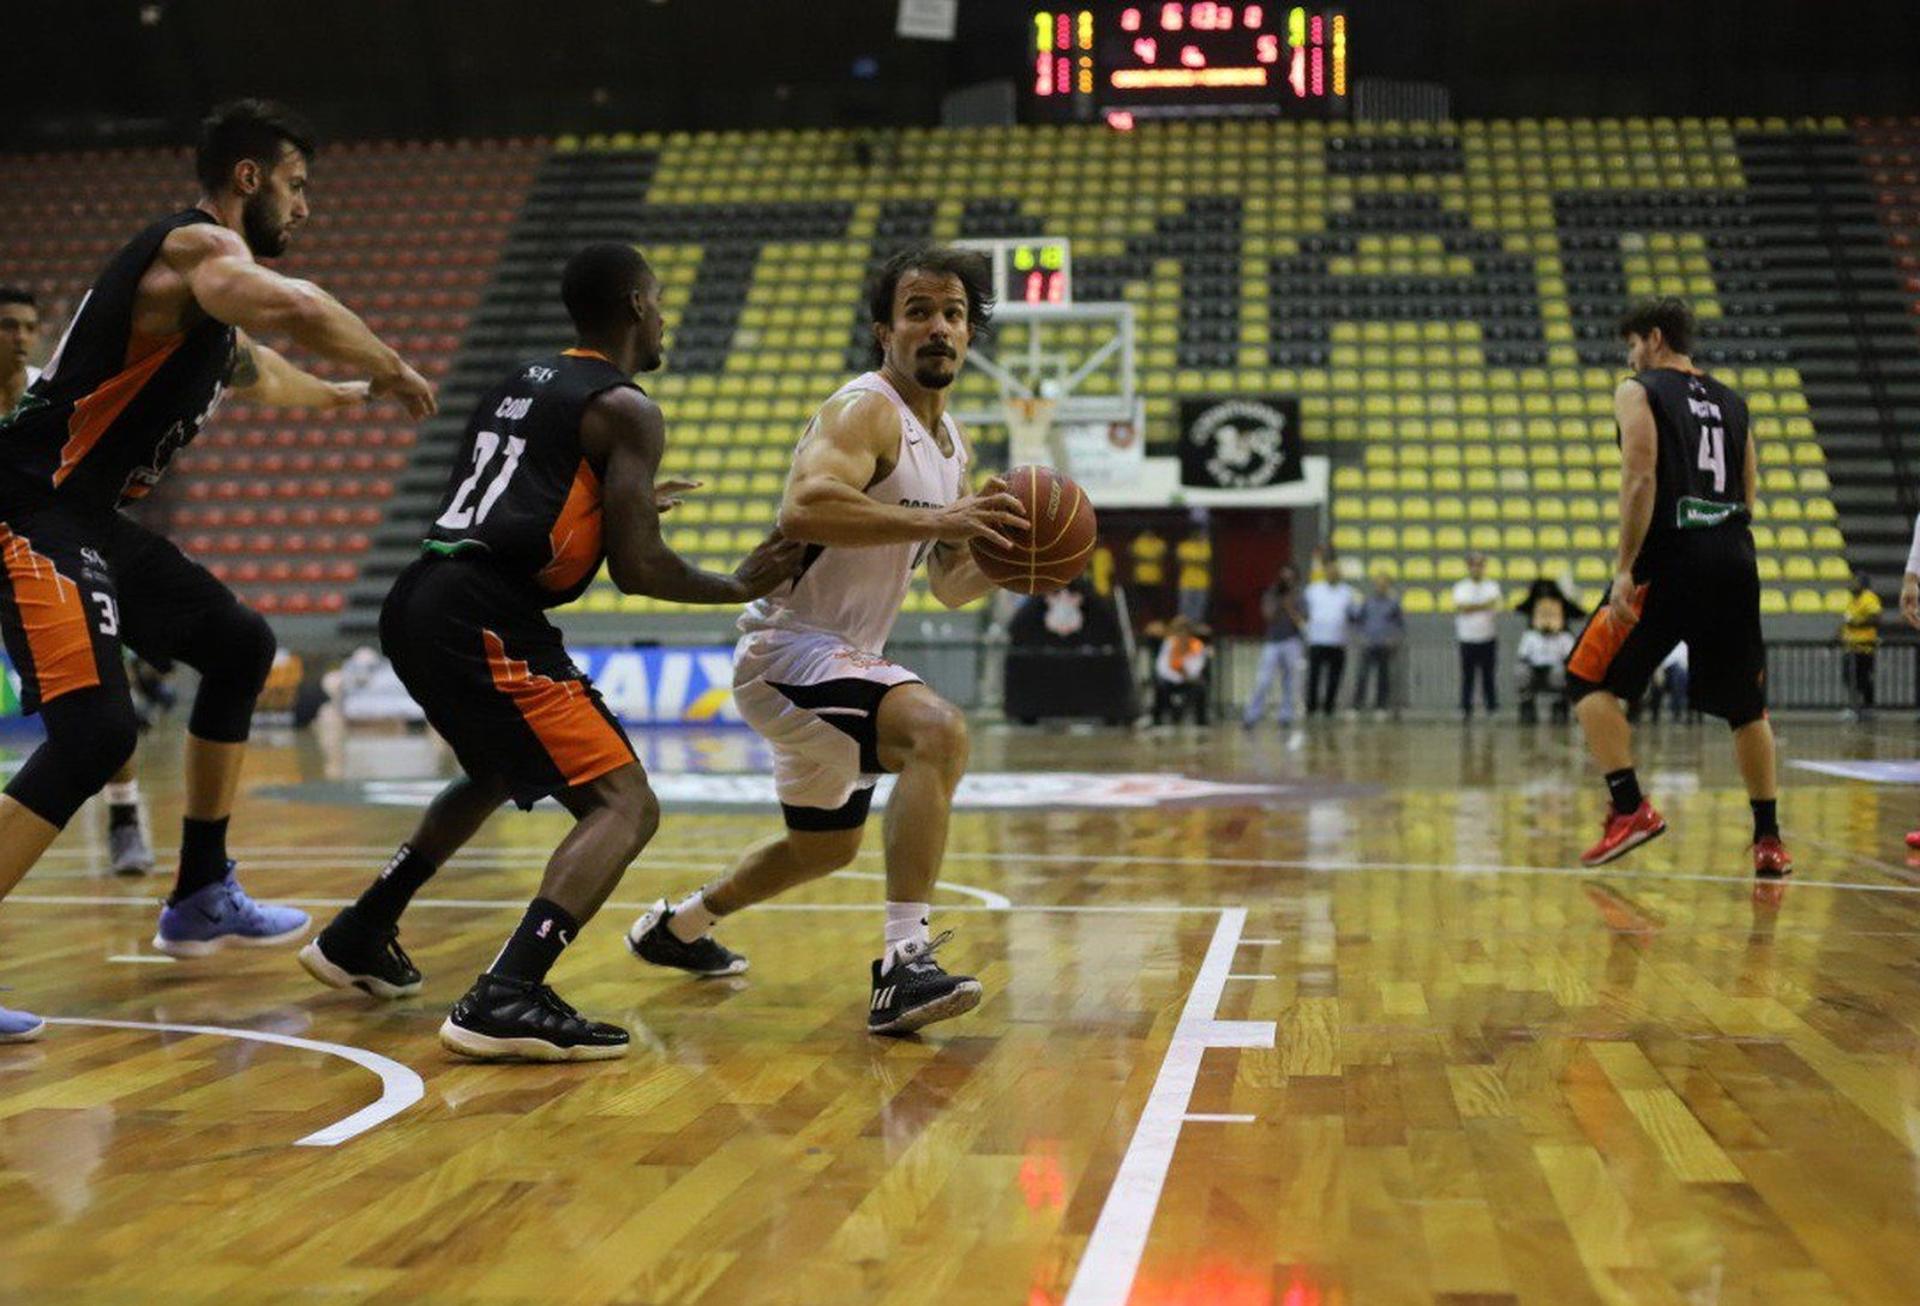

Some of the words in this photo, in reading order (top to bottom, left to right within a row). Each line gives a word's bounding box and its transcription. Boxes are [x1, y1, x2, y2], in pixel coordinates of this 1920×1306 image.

[435, 431, 527, 529] 21
[1697, 424, 1727, 493] 4
[566, 650, 741, 722] AIX
